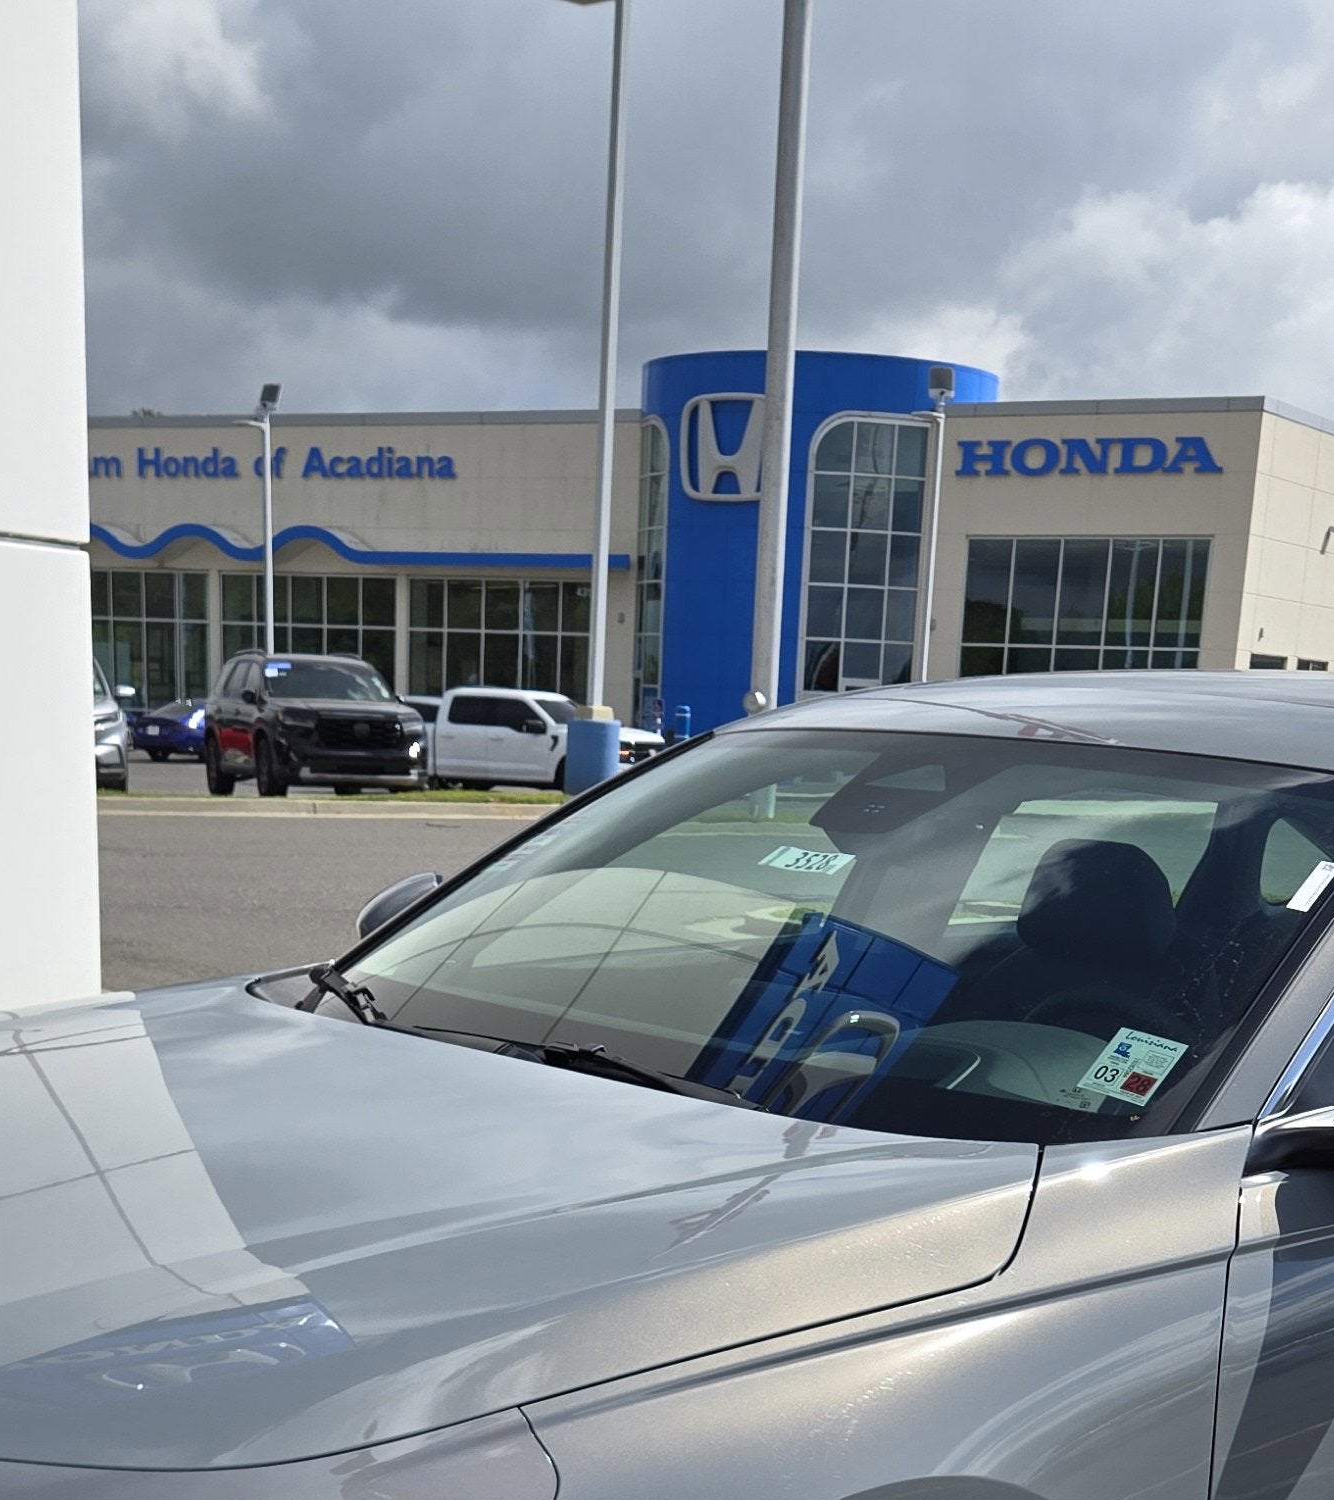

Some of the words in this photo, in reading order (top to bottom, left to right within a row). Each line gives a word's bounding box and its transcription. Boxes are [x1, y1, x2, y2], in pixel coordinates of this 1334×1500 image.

[90, 456, 122, 477] m
[137, 446, 239, 478] Honda
[302, 446, 456, 479] Acadiana
[955, 436, 1223, 477] HONDA
[785, 851, 839, 871] 3528
[1125, 1030, 1178, 1053] Louisiana
[1093, 1065, 1120, 1083] 03
[1129, 1074, 1152, 1096] 28
